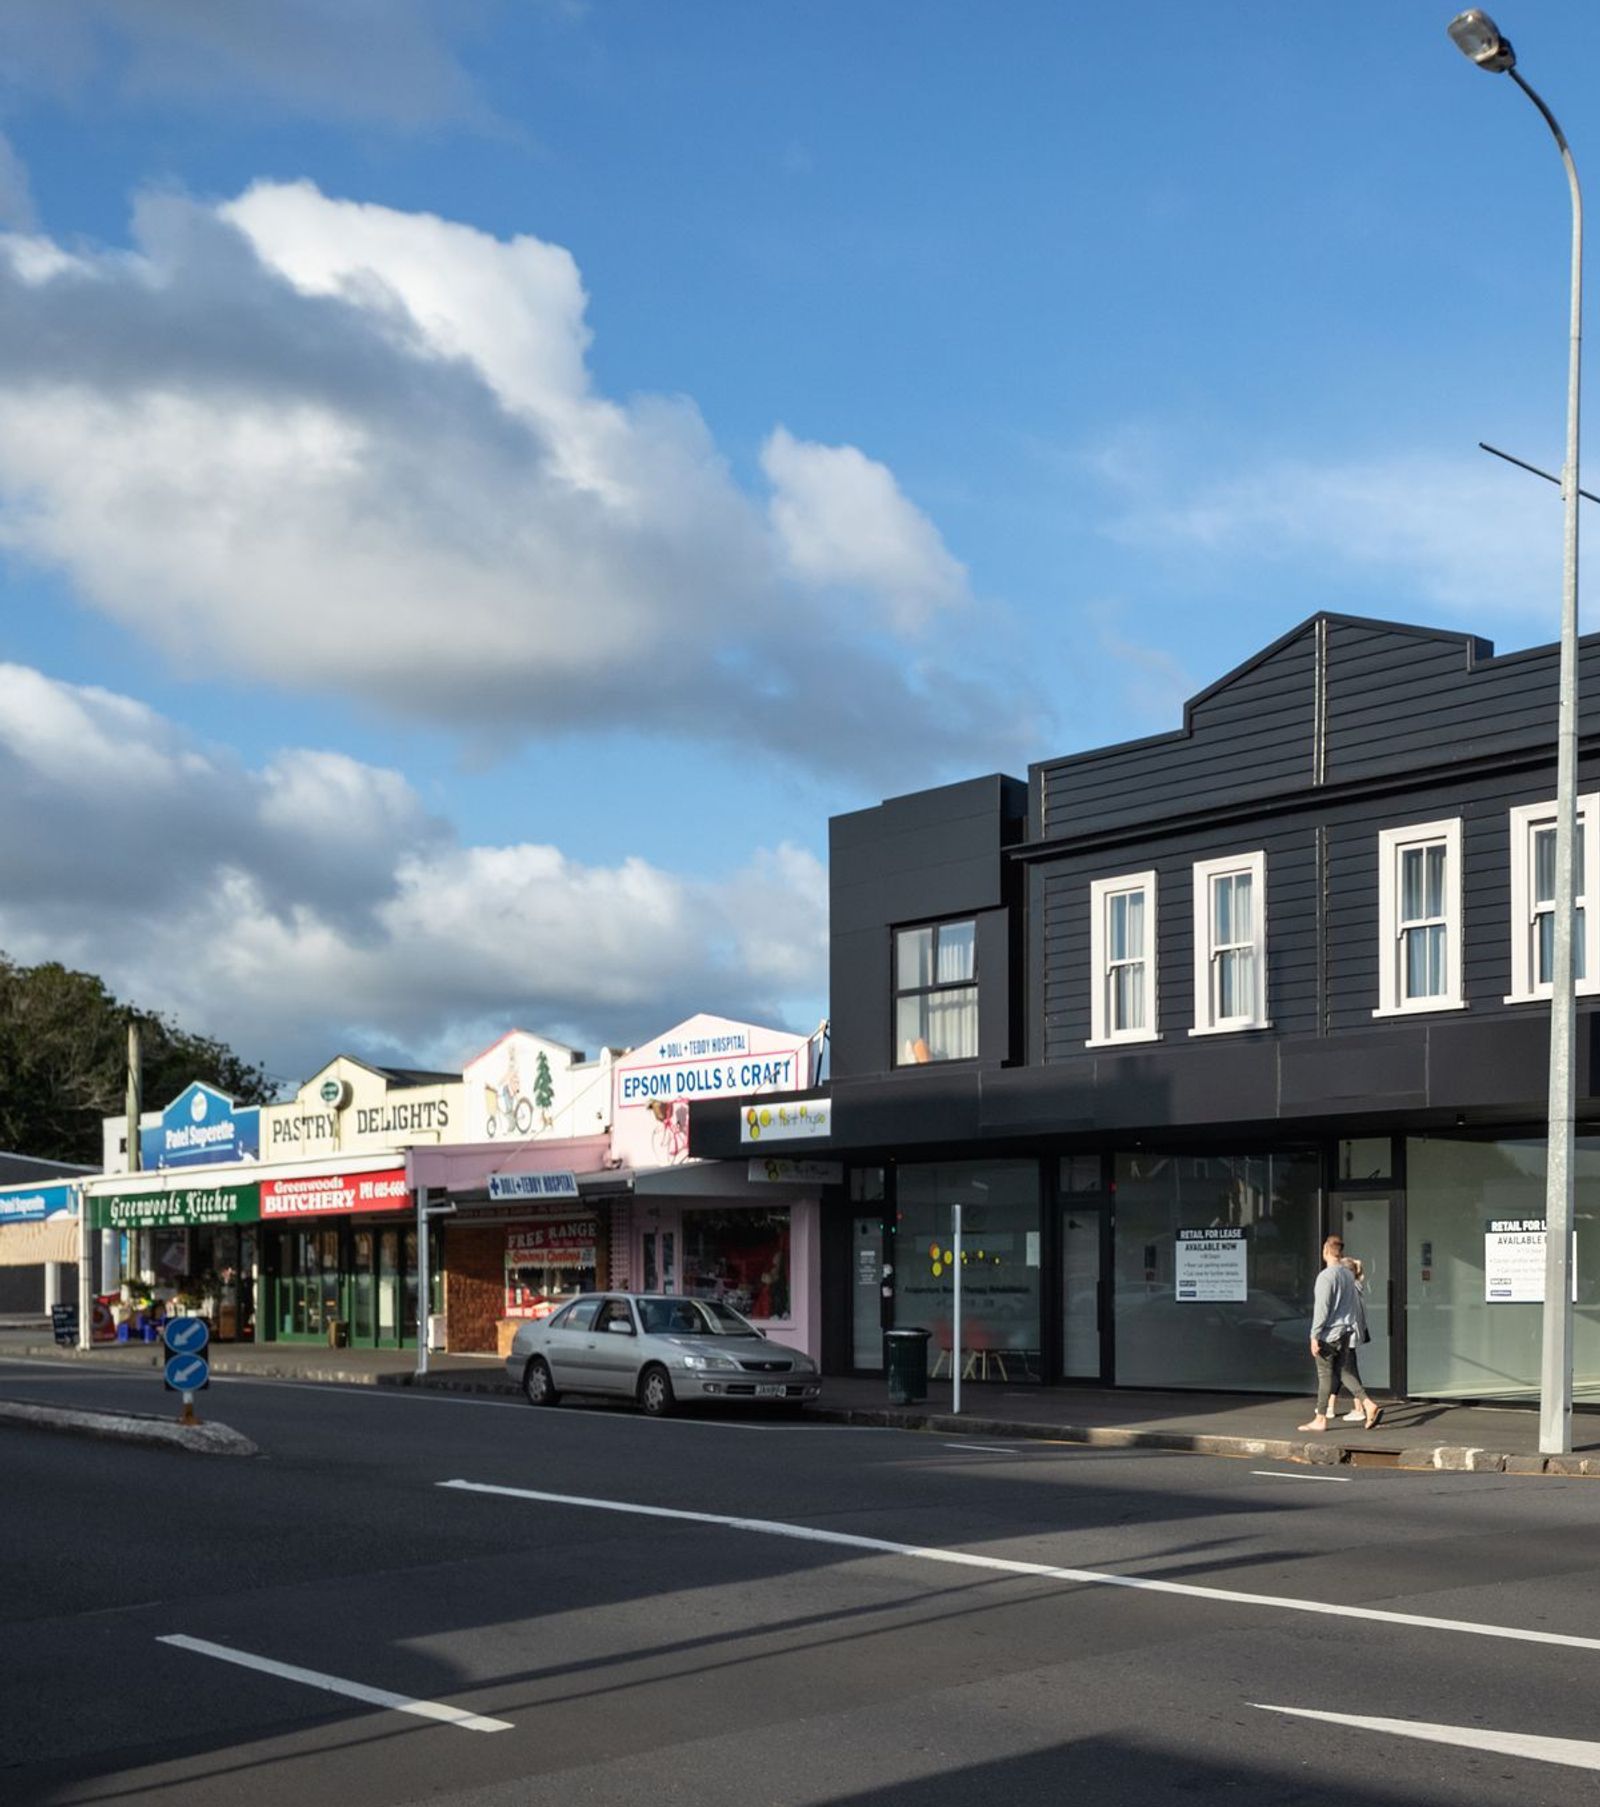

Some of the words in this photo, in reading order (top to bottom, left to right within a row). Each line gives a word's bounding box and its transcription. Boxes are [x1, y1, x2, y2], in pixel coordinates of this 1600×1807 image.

[667, 1042, 683, 1058] DOLL
[689, 1039, 710, 1055] TEDDY
[712, 1035, 746, 1052] HOSPITAL
[624, 1073, 671, 1098] EPSOM
[677, 1068, 722, 1093] DOLLS
[727, 1066, 736, 1088] &
[741, 1061, 790, 1087] CRAFT
[272, 1113, 336, 1143] PASTRY
[357, 1100, 449, 1134] DELIGHTS
[166, 1124, 188, 1149] Patel
[189, 1120, 235, 1148] Superette
[274, 1176, 344, 1195] Greenwoods
[500, 1178, 516, 1195] DOLL
[521, 1175, 542, 1193] TEDDY
[543, 1174, 577, 1193] HOSPITAL
[110, 1190, 181, 1219] Greenwoods
[186, 1189, 237, 1218] Kitchen
[264, 1189, 355, 1213] BUTCHERY
[507, 1229, 544, 1248] FREE
[548, 1222, 597, 1240] RANGE
[1180, 1230, 1204, 1239] RETAIL
[1205, 1229, 1218, 1239] FOR
[1220, 1228, 1242, 1238] LEASE
[1491, 1220, 1522, 1232] RETAIL
[1522, 1220, 1540, 1231] FOR
[1185, 1243, 1220, 1251] AVAILABLE
[1498, 1235, 1542, 1245] AVAILABLE
